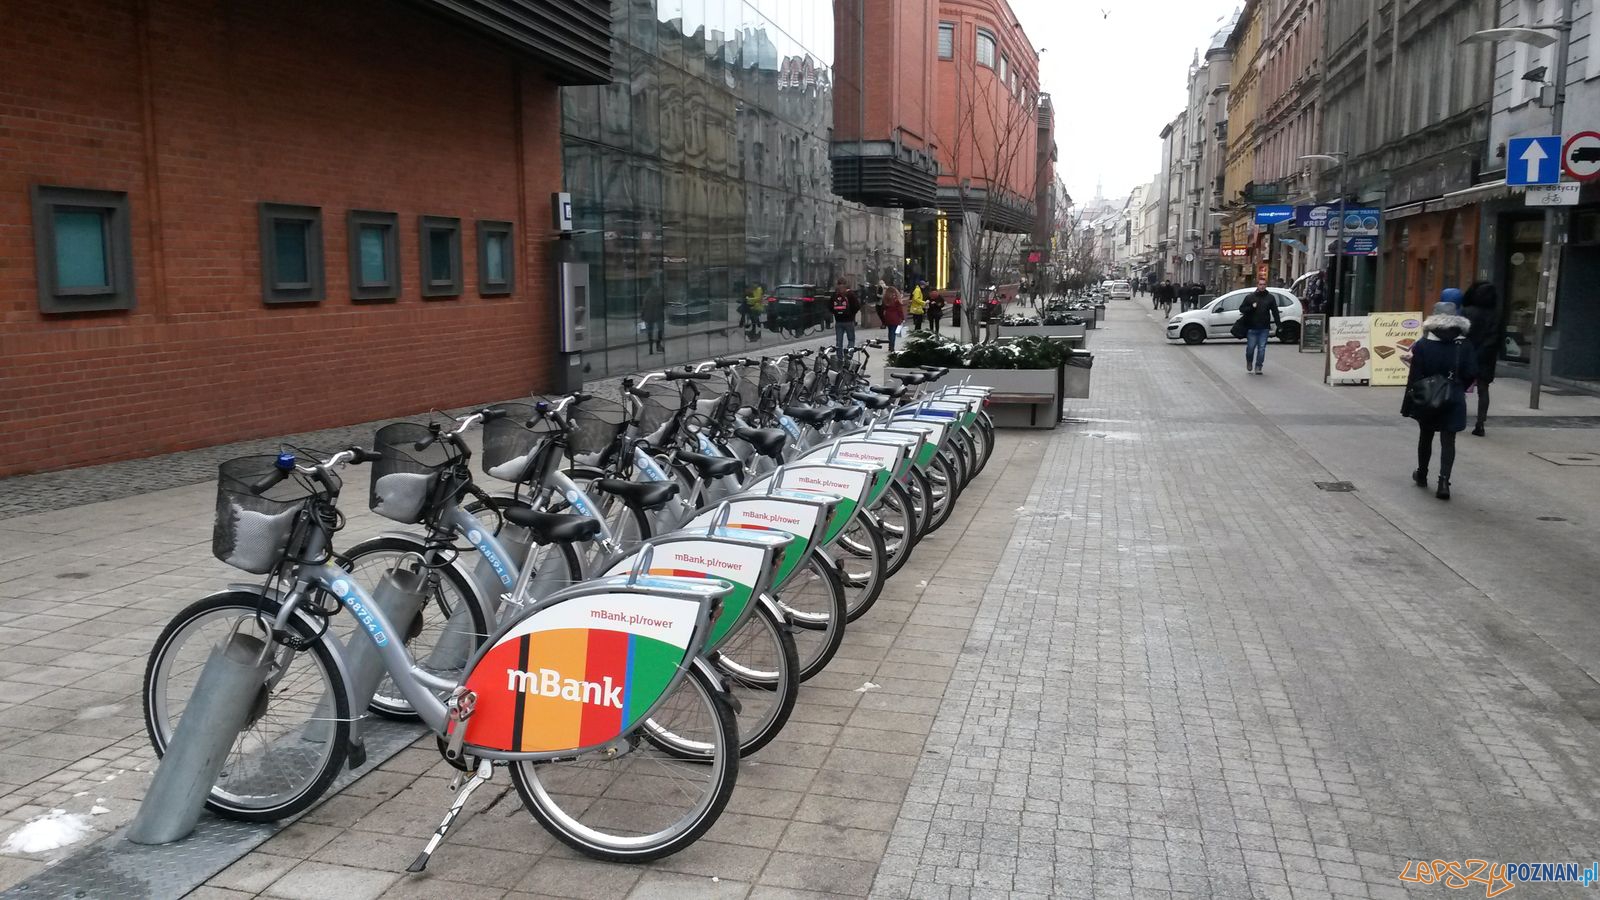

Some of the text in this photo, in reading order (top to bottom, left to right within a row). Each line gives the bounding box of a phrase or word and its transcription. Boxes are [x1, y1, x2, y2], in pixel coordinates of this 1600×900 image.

[839, 450, 885, 462] mBank.pl/rower
[798, 475, 850, 490] mBank.pl/rower
[742, 510, 801, 526] mBank.pl/rower
[674, 552, 743, 571] mBank.pl/rower
[347, 597, 377, 632] 68754
[590, 609, 674, 629] mBank.pl/rower
[506, 667, 624, 710] mBank
